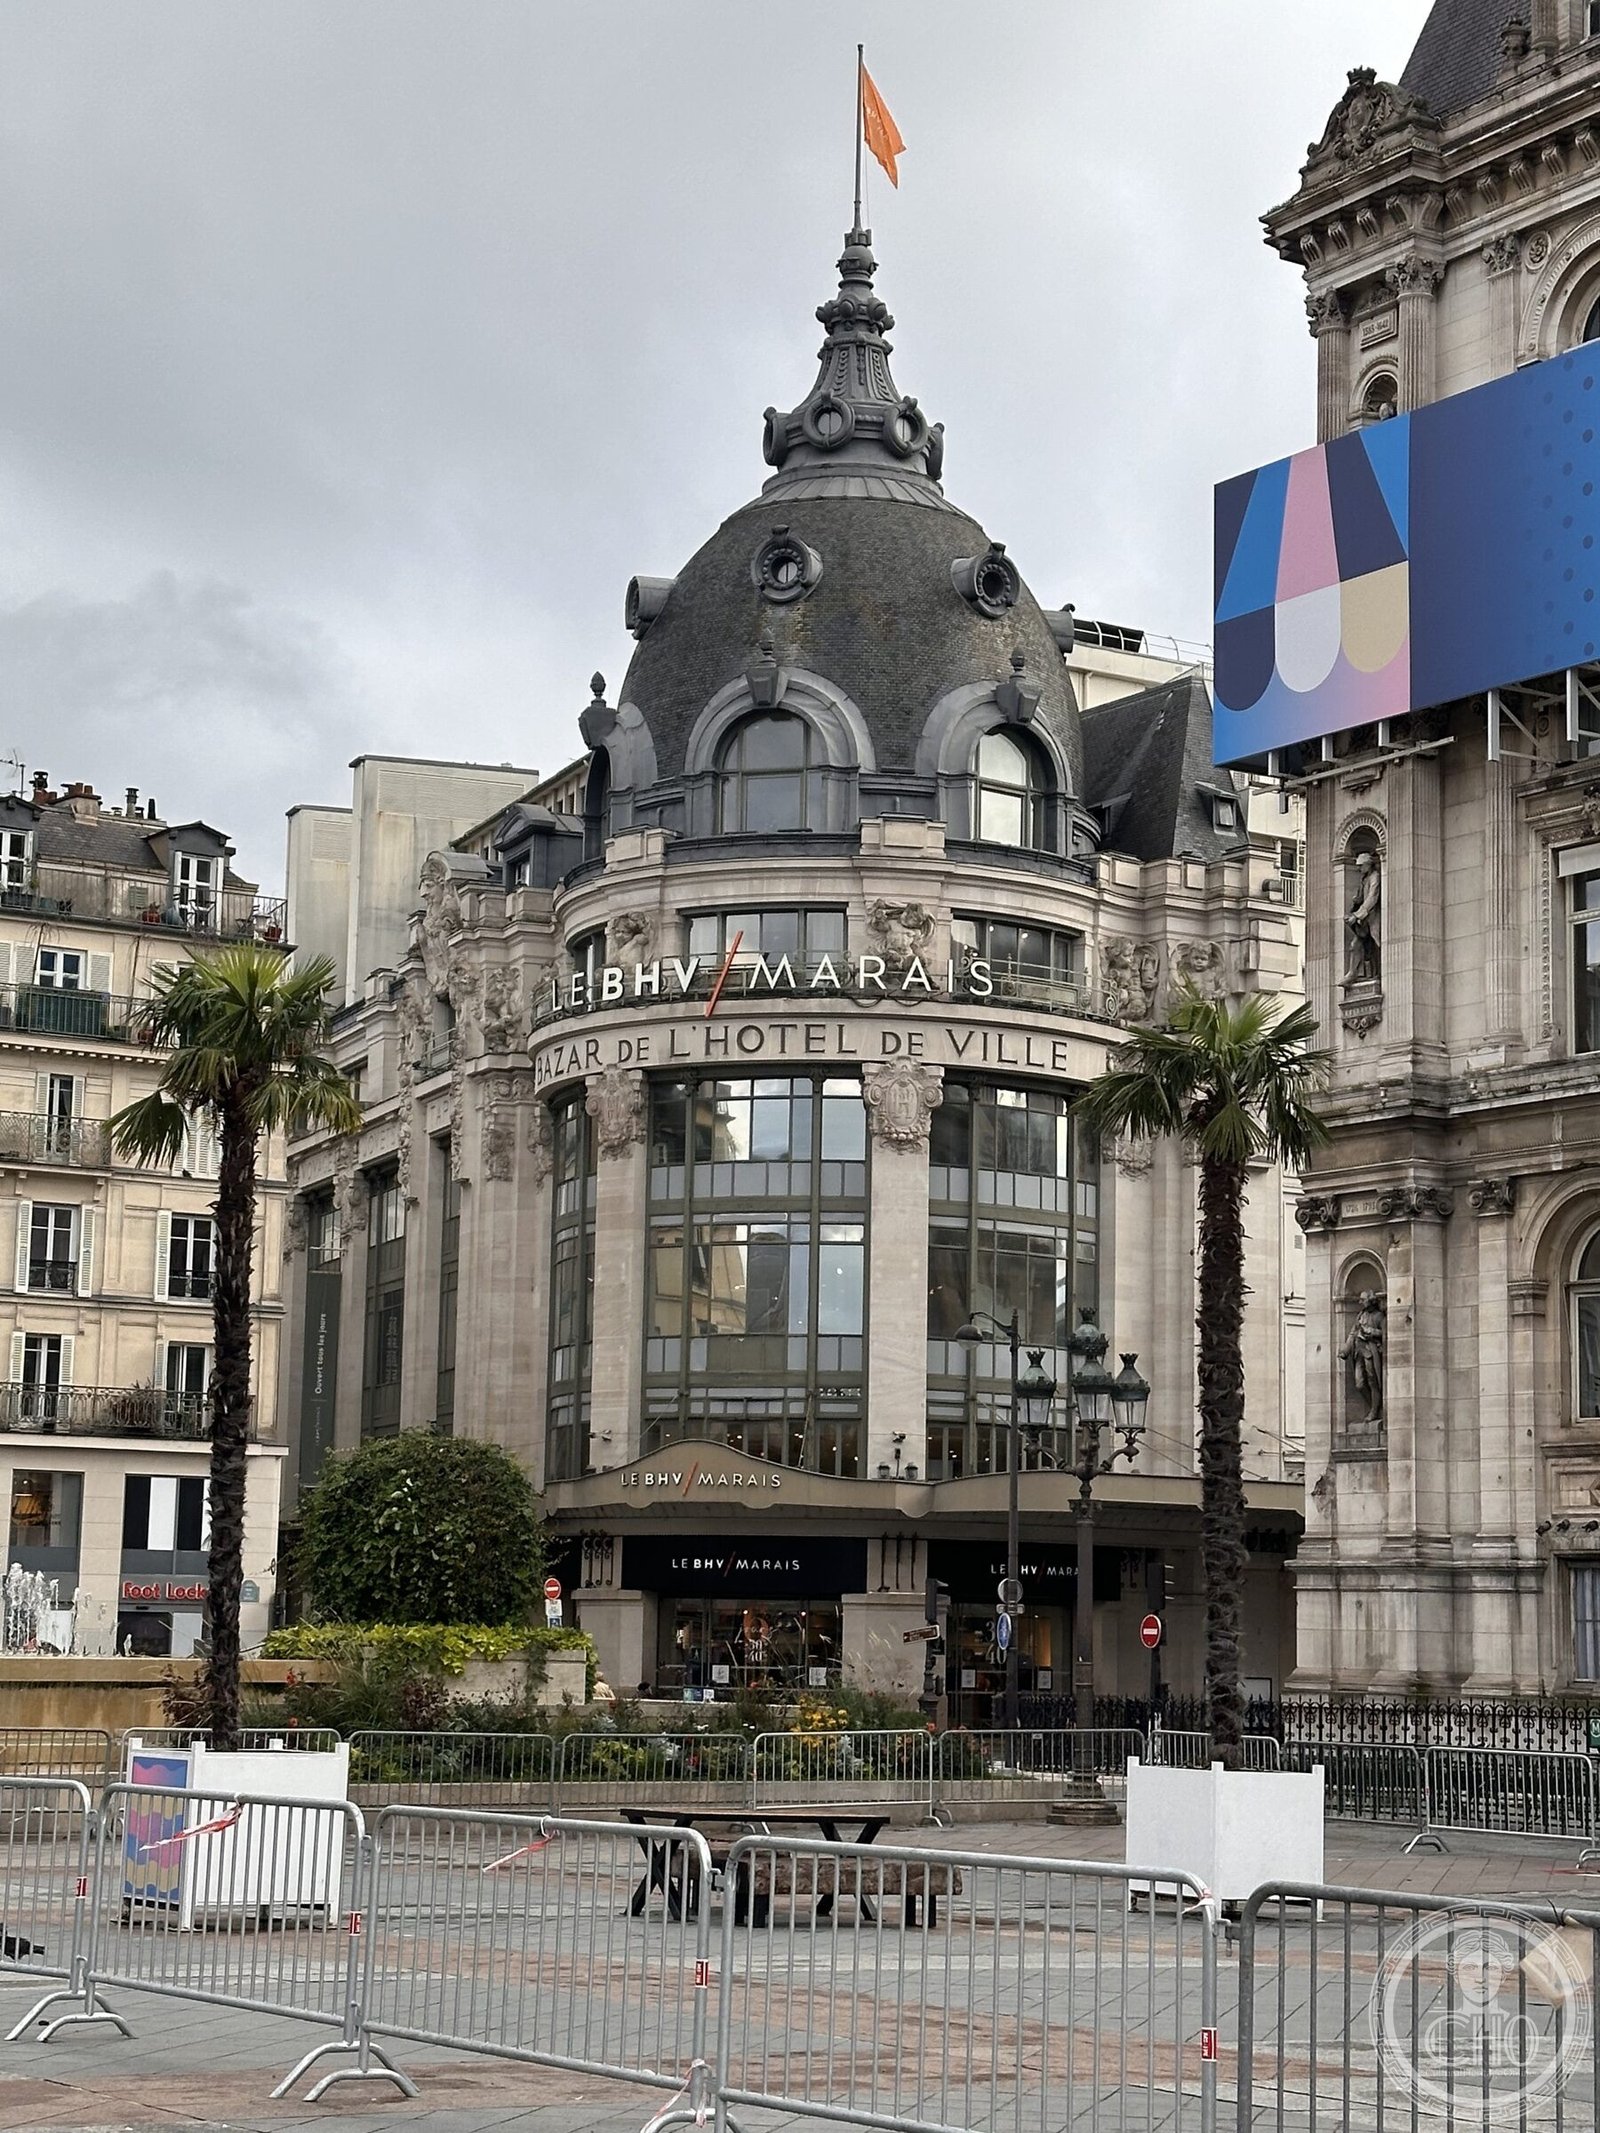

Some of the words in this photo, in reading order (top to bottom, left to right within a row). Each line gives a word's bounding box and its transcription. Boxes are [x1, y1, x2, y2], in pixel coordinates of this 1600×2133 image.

[552, 971, 585, 1012] LE
[602, 957, 700, 1002] BHV
[749, 953, 994, 997] MARAIS
[535, 1038, 603, 1085] BAZAR
[617, 1037, 650, 1064] DE
[669, 1024, 858, 1058] L'HOTEL
[880, 1031, 924, 1057] DE
[945, 1028, 1068, 1072] VILLE
[620, 1473, 639, 1486] LE
[644, 1472, 683, 1486] BHV
[697, 1473, 782, 1488] MARAIS
[672, 1559, 688, 1569] LE
[693, 1558, 724, 1569] BHV
[735, 1559, 800, 1570] MARAIS
[990, 1563, 1006, 1575] LE
[1046, 1566, 1079, 1576] MARA
[122, 1581, 161, 1599] Foot
[166, 1582, 209, 1600] Lock
